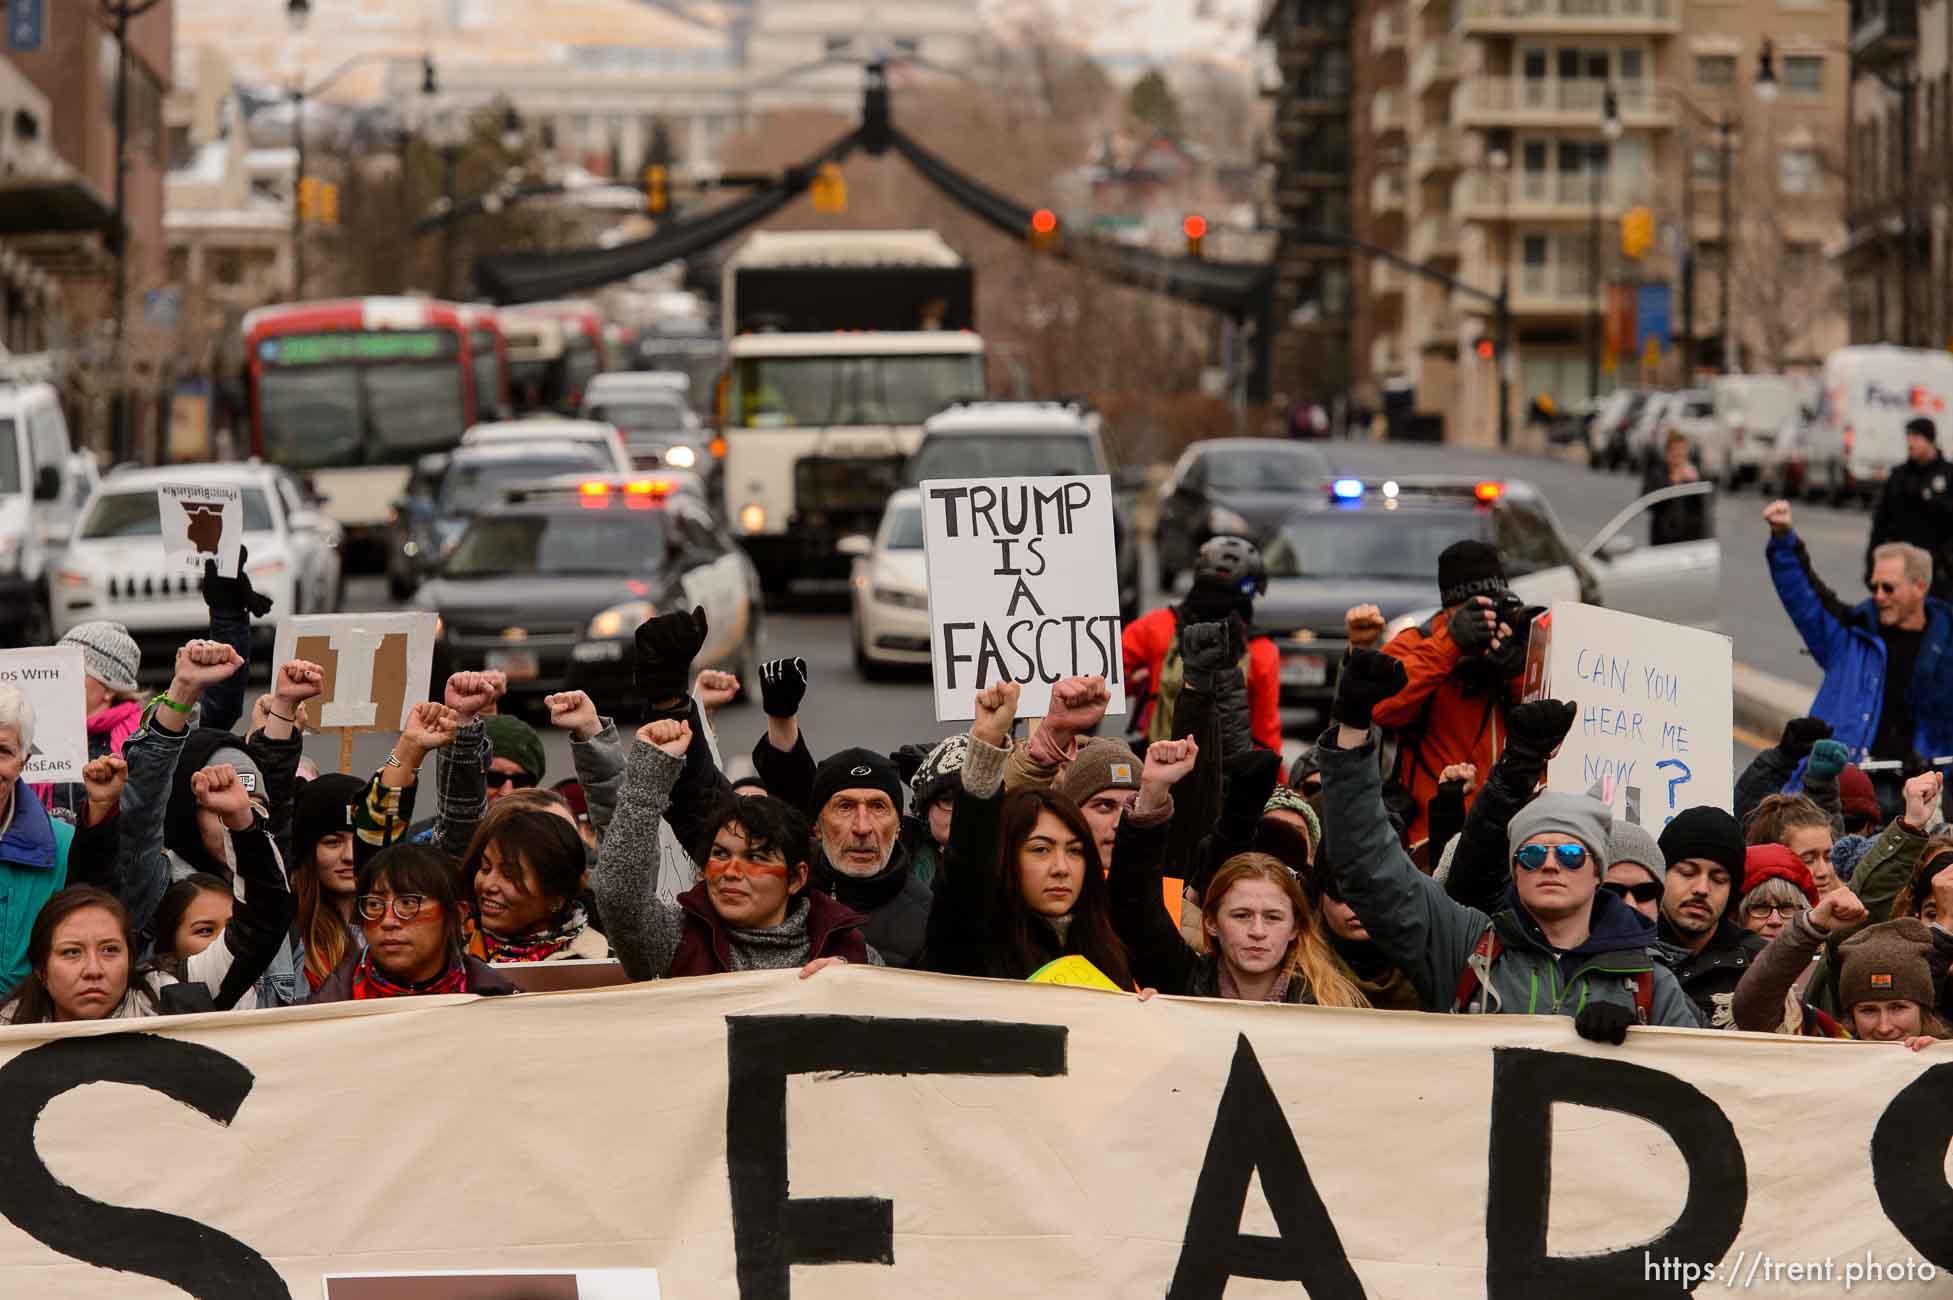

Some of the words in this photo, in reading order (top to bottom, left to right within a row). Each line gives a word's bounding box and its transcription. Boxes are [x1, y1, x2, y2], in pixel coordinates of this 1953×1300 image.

[930, 481, 1091, 537] TRUMP
[993, 537, 1046, 576] IS
[1006, 575, 1046, 617] A
[22, 667, 60, 681] WITH
[943, 615, 1121, 690] FASCIST
[1576, 648, 1630, 694] CAN
[1644, 667, 1679, 705] YOU
[1583, 705, 1646, 742] HEAR
[1662, 721, 1690, 753] ME
[1582, 753, 1638, 785] NOW
